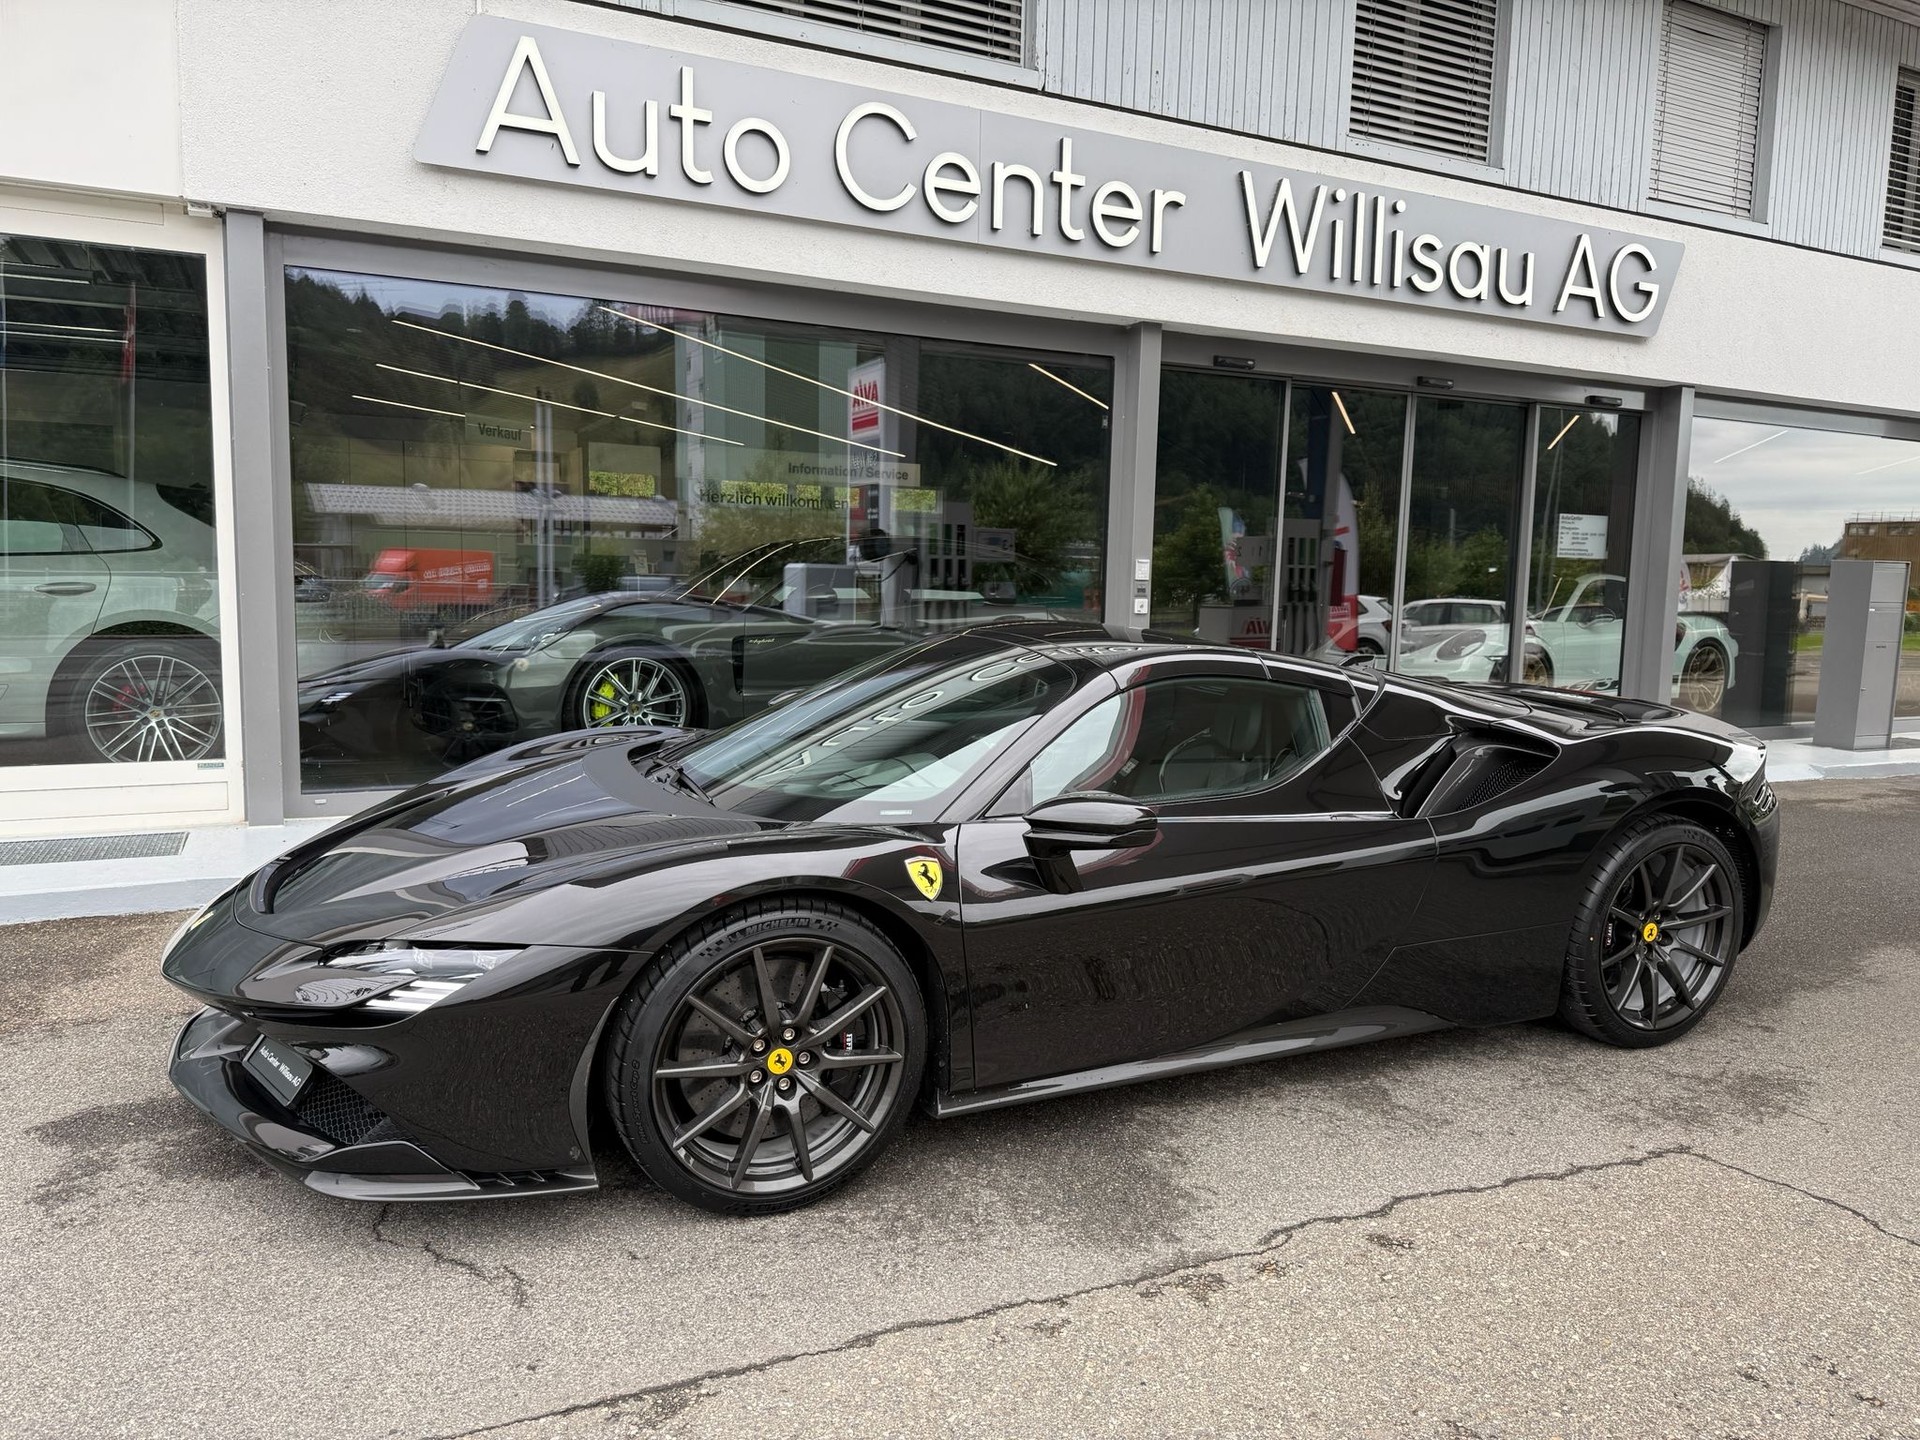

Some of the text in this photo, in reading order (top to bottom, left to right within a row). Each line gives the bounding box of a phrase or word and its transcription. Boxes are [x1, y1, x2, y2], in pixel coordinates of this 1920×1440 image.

[475, 36, 1660, 323] Auto Center Willisau AG
[478, 422, 521, 441] Verkauf
[788, 462, 857, 478] Information
[866, 466, 909, 481] Service
[700, 488, 762, 506] Herzlich
[744, 918, 811, 937] MICHELIN
[267, 1053, 281, 1068] Center
[291, 1075, 302, 1087] AG
[631, 1059, 640, 1070] 2
[630, 1069, 640, 1090] Cup
[631, 1090, 641, 1122] Sport
